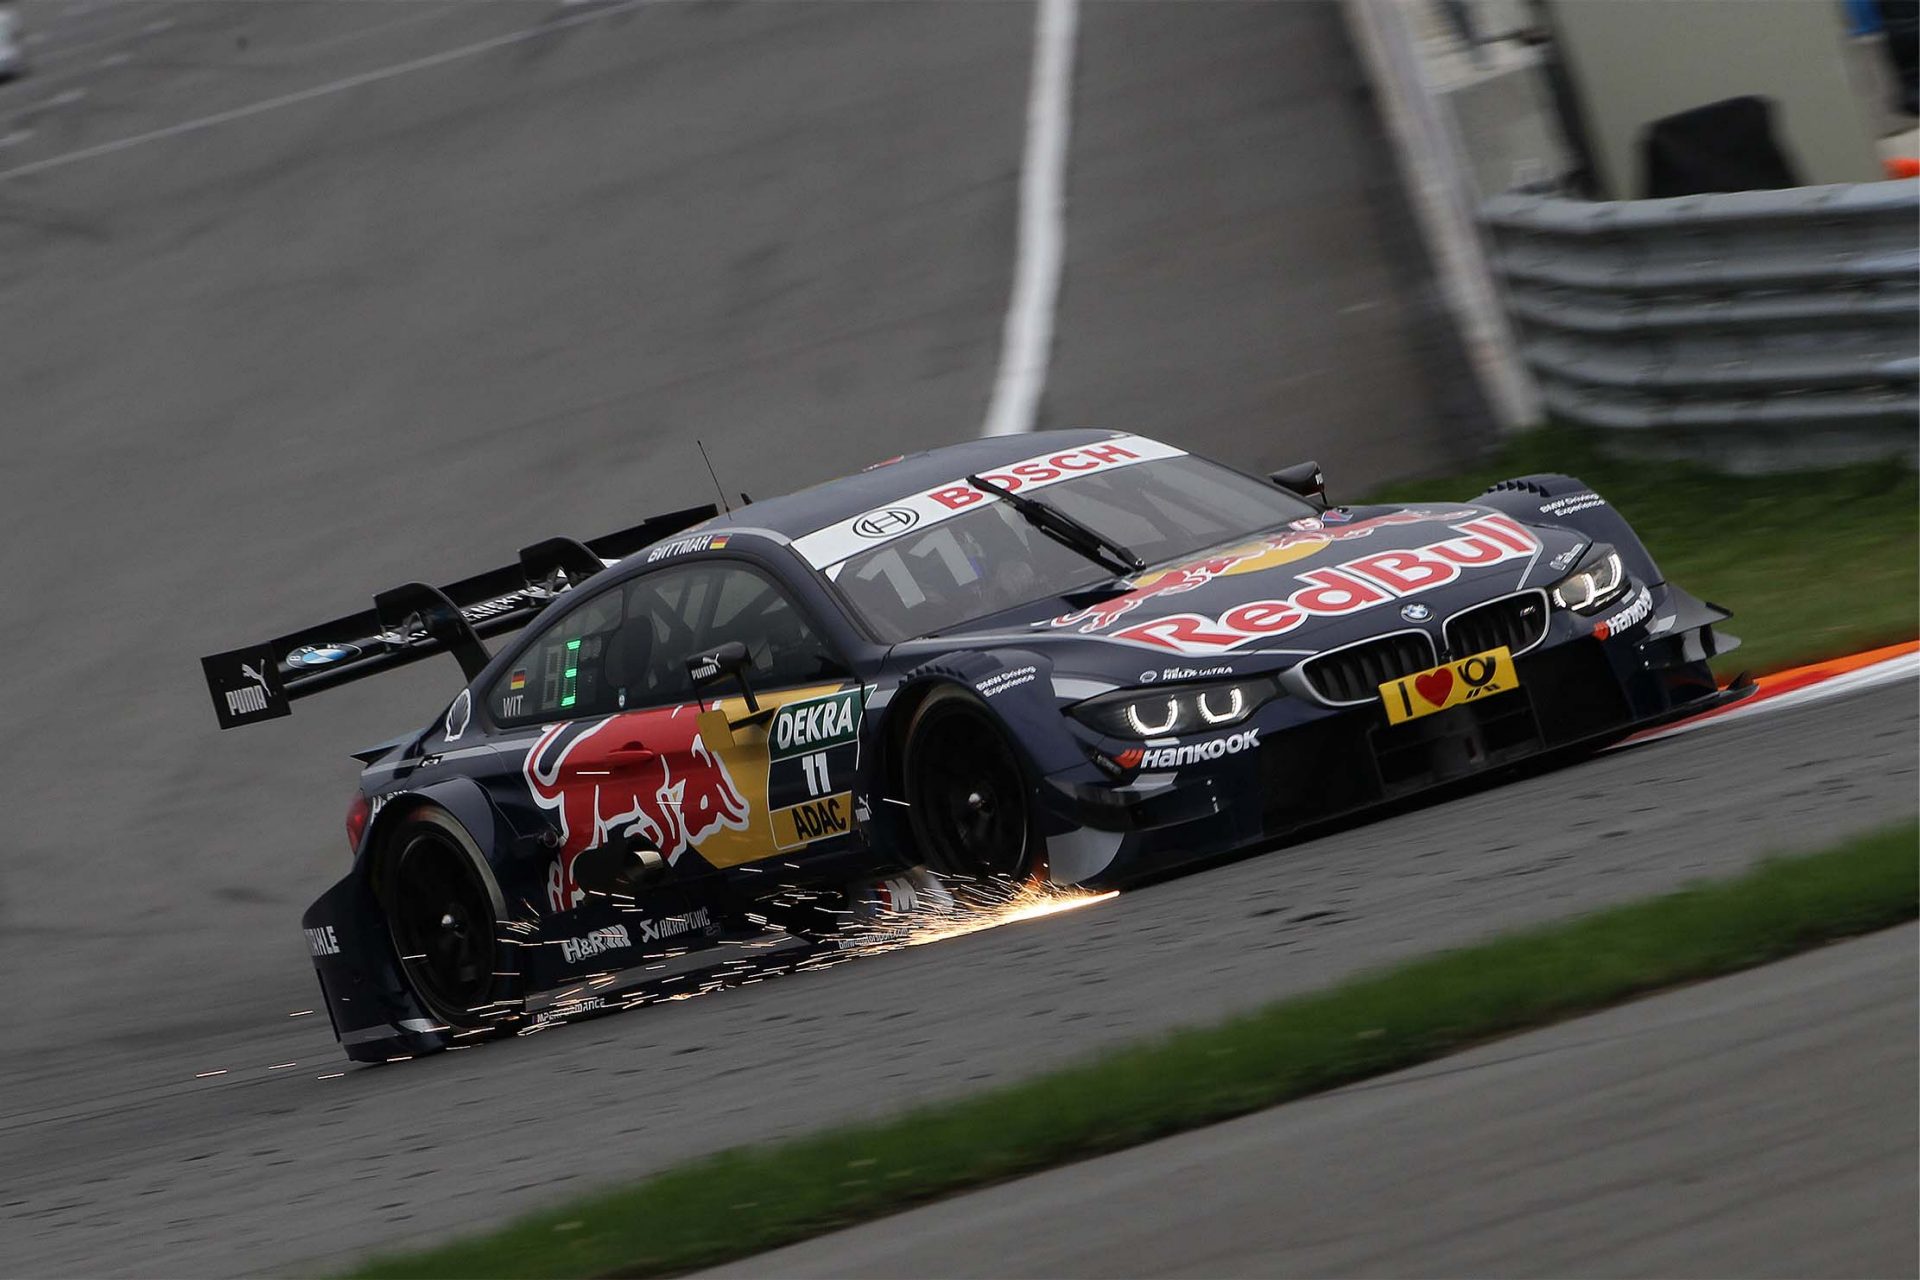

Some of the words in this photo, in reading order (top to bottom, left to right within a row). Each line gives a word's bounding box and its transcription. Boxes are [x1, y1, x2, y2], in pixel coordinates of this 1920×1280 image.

[928, 444, 1140, 510] BOSCH
[856, 527, 979, 610] 11
[224, 684, 269, 716] PUMA
[502, 695, 525, 719] WIT
[777, 697, 853, 749] DEKRA
[802, 752, 832, 797] 11
[791, 799, 846, 841] ADAC
